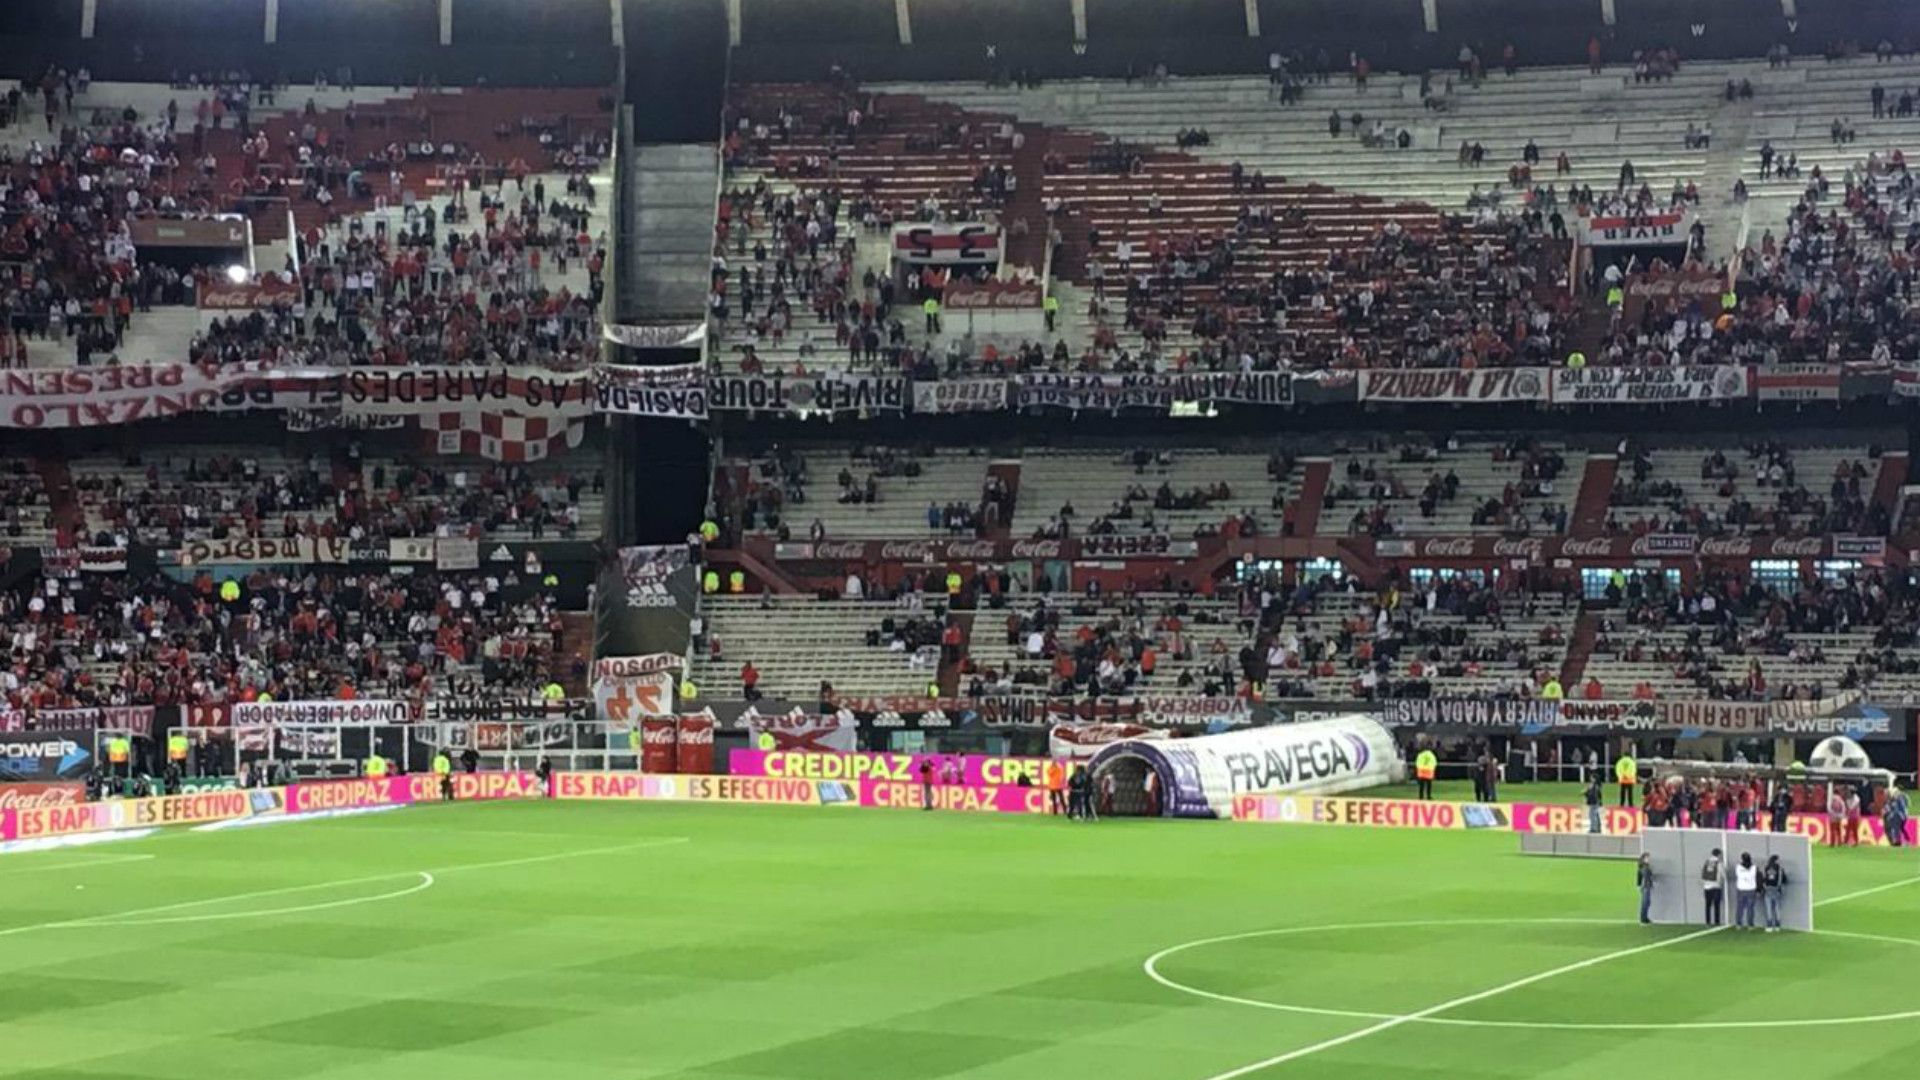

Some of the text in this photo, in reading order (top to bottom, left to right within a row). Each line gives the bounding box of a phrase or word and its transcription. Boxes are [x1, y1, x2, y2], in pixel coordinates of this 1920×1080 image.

[1691, 23, 1705, 36] W
[986, 44, 996, 58] X
[0, 364, 184, 396] PRESEN
[350, 369, 508, 405] PAREDES
[525, 376, 587, 410] LAS
[597, 385, 706, 416] CASILDA
[709, 378, 788, 410] TOUR
[815, 378, 904, 410] RIVER
[12, 388, 218, 428] ONZALO
[816, 542, 864, 559] Coca-Cola
[947, 541, 995, 559] Coca-Cola
[1012, 540, 1060, 558] Coca-Cola
[1425, 538, 1474, 556] Coca-Cola
[1562, 537, 1611, 556] Coca-Cola
[1771, 537, 1823, 556] Coca-Cola
[626, 595, 678, 608] adidas
[239, 704, 344, 726] LIBERTADOR
[1441, 701, 1489, 723] NADA
[1503, 701, 1555, 723] RIVER
[763, 752, 914, 782] CREDIPAZ
[1225, 736, 1351, 792] FRAVEGA
[296, 780, 392, 811] CREDIPAZ
[562, 776, 585, 796] ES
[688, 778, 714, 799] ES
[717, 778, 812, 802] EFECTIVO
[21, 810, 45, 833] ES
[136, 802, 156, 823] ES
[162, 792, 246, 822] EFECTIVO
[1312, 800, 1338, 822] ES
[1346, 801, 1455, 828] EFECTIVO
